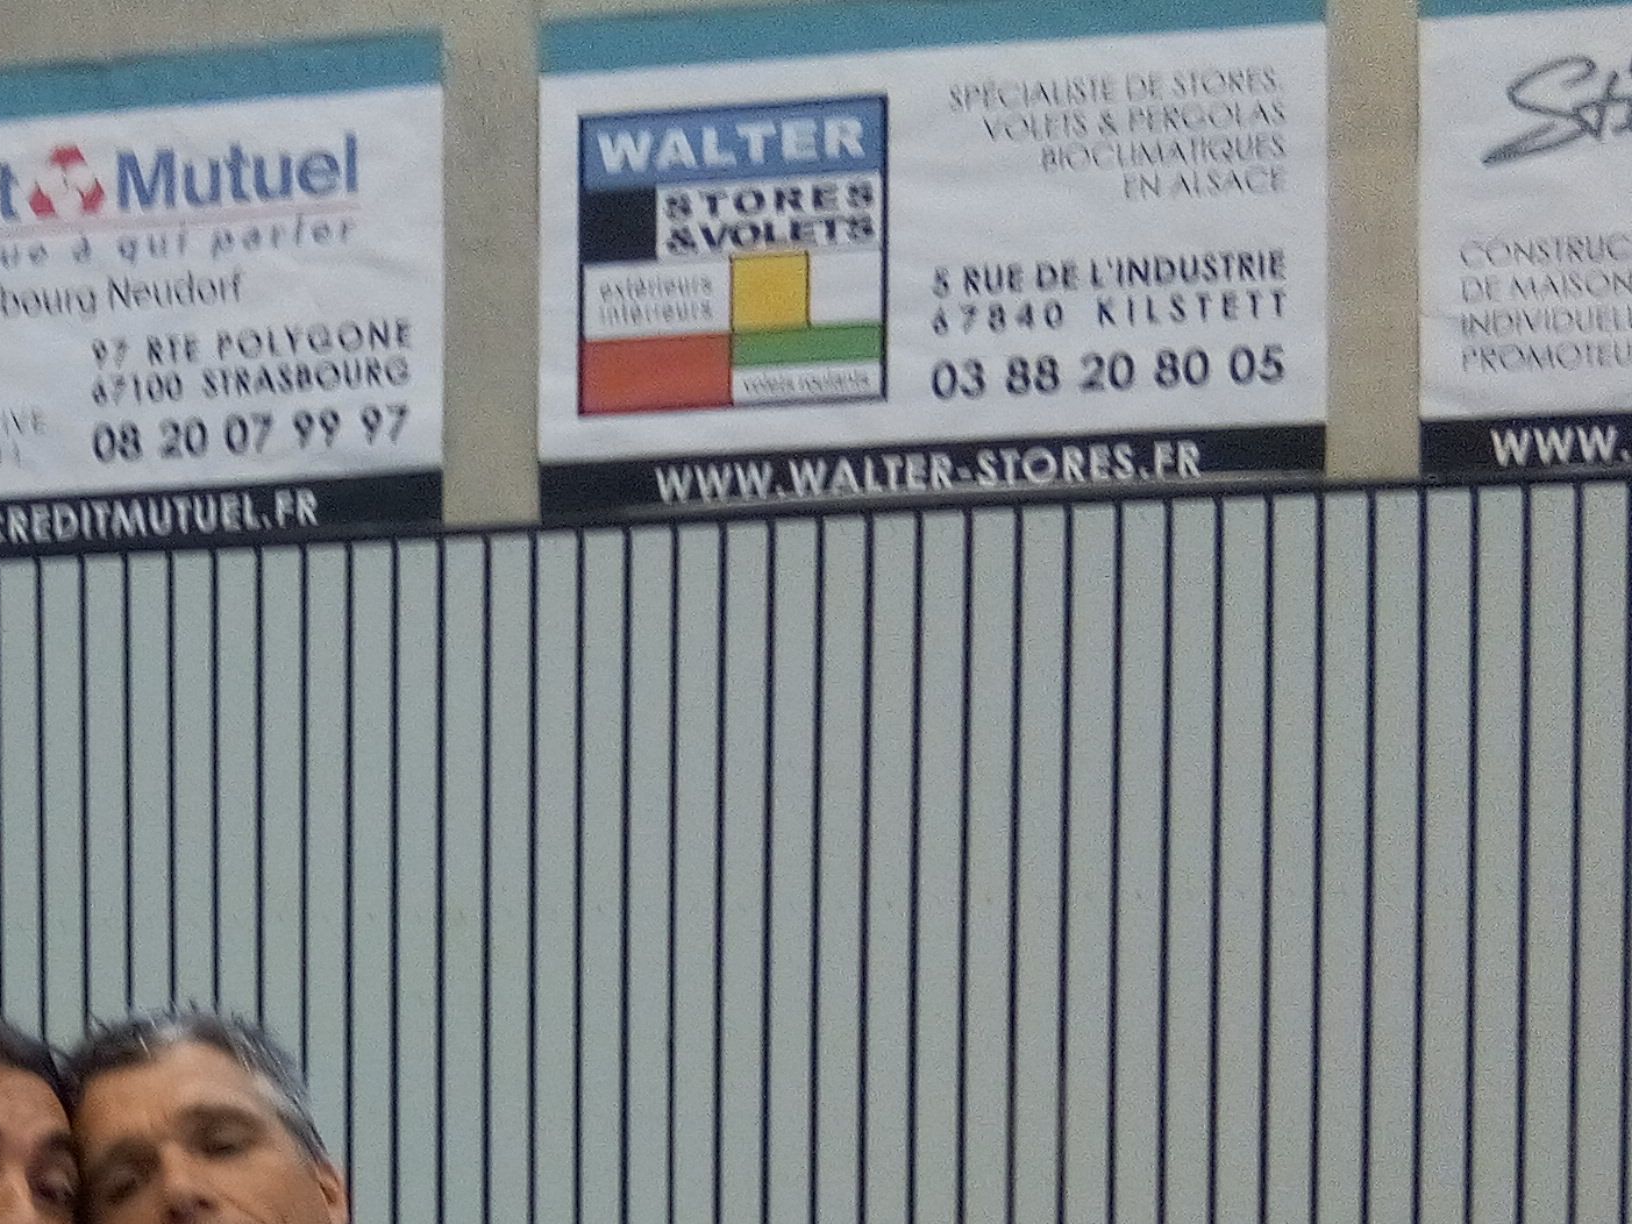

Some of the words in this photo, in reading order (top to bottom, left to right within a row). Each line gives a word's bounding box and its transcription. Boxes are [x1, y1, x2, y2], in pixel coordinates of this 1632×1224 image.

[1126, 72, 1161, 101] DE
[595, 115, 865, 175] WALTER
[983, 111, 1088, 142] VOLETS
[1128, 101, 1286, 133] PERGOLAS
[115, 132, 358, 209] Mutuel
[1041, 133, 1286, 173] BIOCLIMATIQUES
[665, 181, 874, 220] STORES
[1123, 170, 1160, 200] EN
[1169, 164, 1287, 199] ALSACE
[116, 219, 189, 263] qui
[210, 213, 358, 261] parler
[107, 266, 244, 310] Neudorf
[932, 266, 950, 298] 5
[963, 261, 1023, 296] RUE
[1036, 259, 1077, 291] DE
[1090, 248, 1285, 290] L'INDUSTRIE
[1461, 274, 1499, 303] DE
[932, 299, 1063, 336] 67840
[1097, 289, 1286, 328] KILSTETT
[217, 318, 411, 360] POLYGONE
[92, 371, 183, 407] 67100
[202, 354, 410, 399] STRASBOURG
[932, 357, 985, 400] 03
[1006, 353, 1061, 395] 88
[1079, 349, 1135, 392] 20
[1155, 346, 1209, 389] 80
[1229, 343, 1285, 385] 05
[92, 420, 142, 463] 08
[159, 416, 208, 459] 20
[224, 411, 273, 456] 07
[292, 407, 341, 449] 99
[360, 401, 409, 445] 97
[654, 440, 1202, 503] WWW.WALTER-STORES.FR
